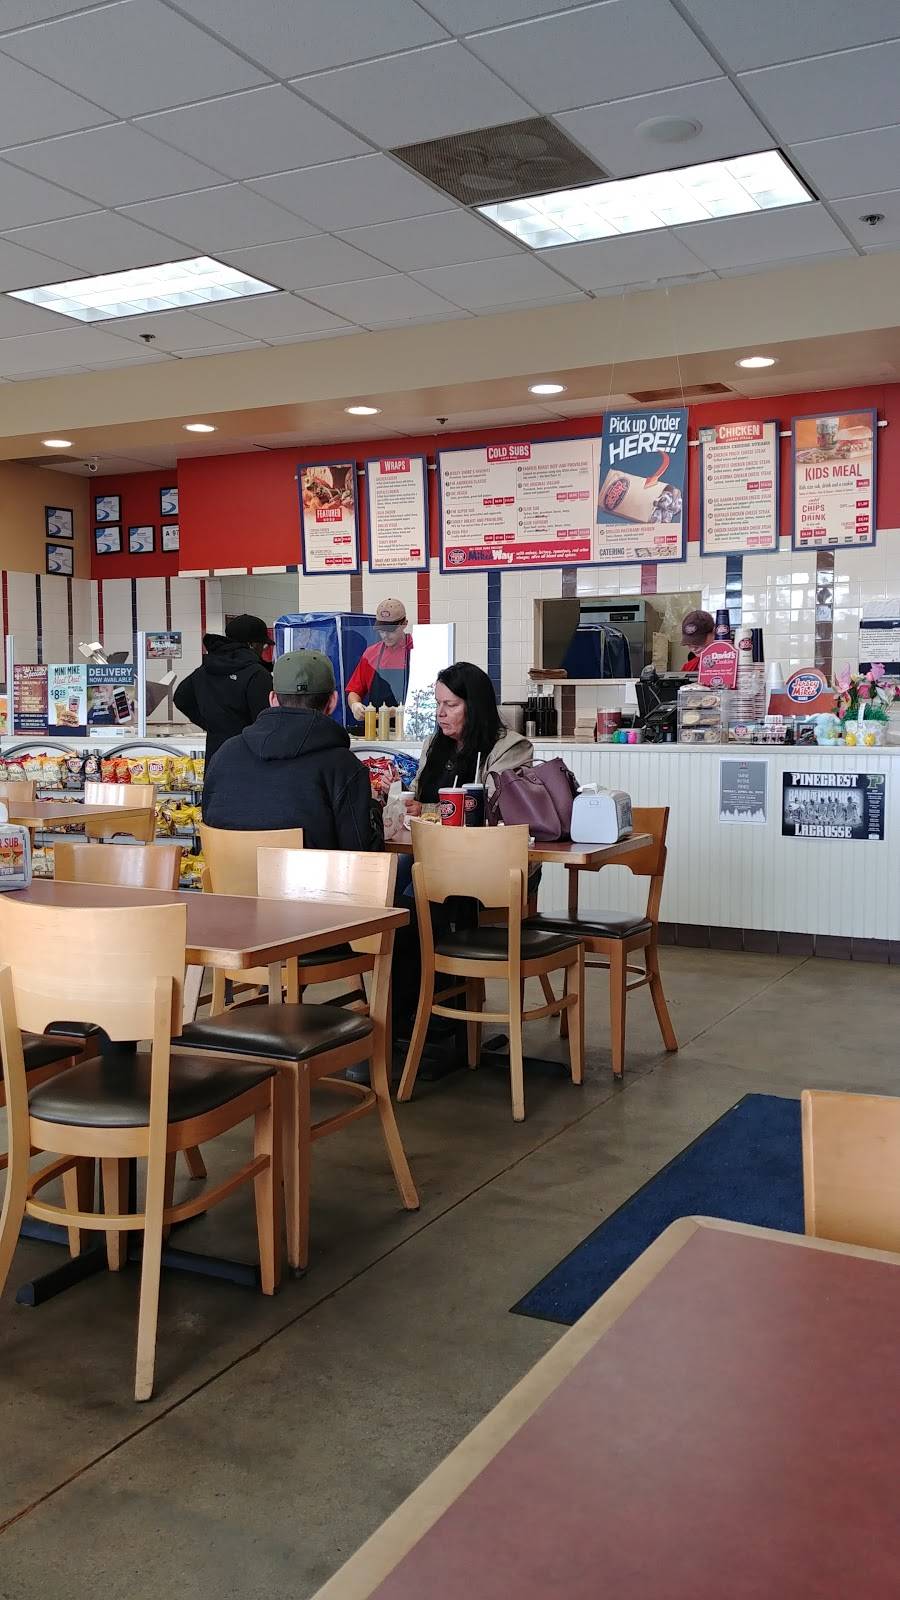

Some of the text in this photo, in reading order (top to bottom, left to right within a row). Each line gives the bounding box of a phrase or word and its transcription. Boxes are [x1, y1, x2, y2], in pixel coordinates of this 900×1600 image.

[610, 414, 681, 434] Pick up Order
[718, 424, 760, 440] CHICKEN
[488, 445, 529, 459] COLD SUBS
[609, 432, 682, 465] HERE!!
[384, 460, 406, 471] WRAPS
[806, 464, 862, 481] KIDS MEAL
[802, 504, 824, 512] CHIPS
[802, 514, 826, 522] DRINK
[492, 548, 514, 564] Way
[600, 548, 624, 556] CATERING
[712, 650, 736, 660] David's
[54, 666, 80, 676] MINI MIKE
[88, 668, 132, 676] DELIVERY
[792, 678, 820, 688] Jersey
[792, 686, 818, 696] Mike's
[791, 772, 859, 788] PINECREST
[866, 775, 884, 789] P
[794, 824, 852, 838] LACROSSE
[4, 838, 18, 848] SUB
